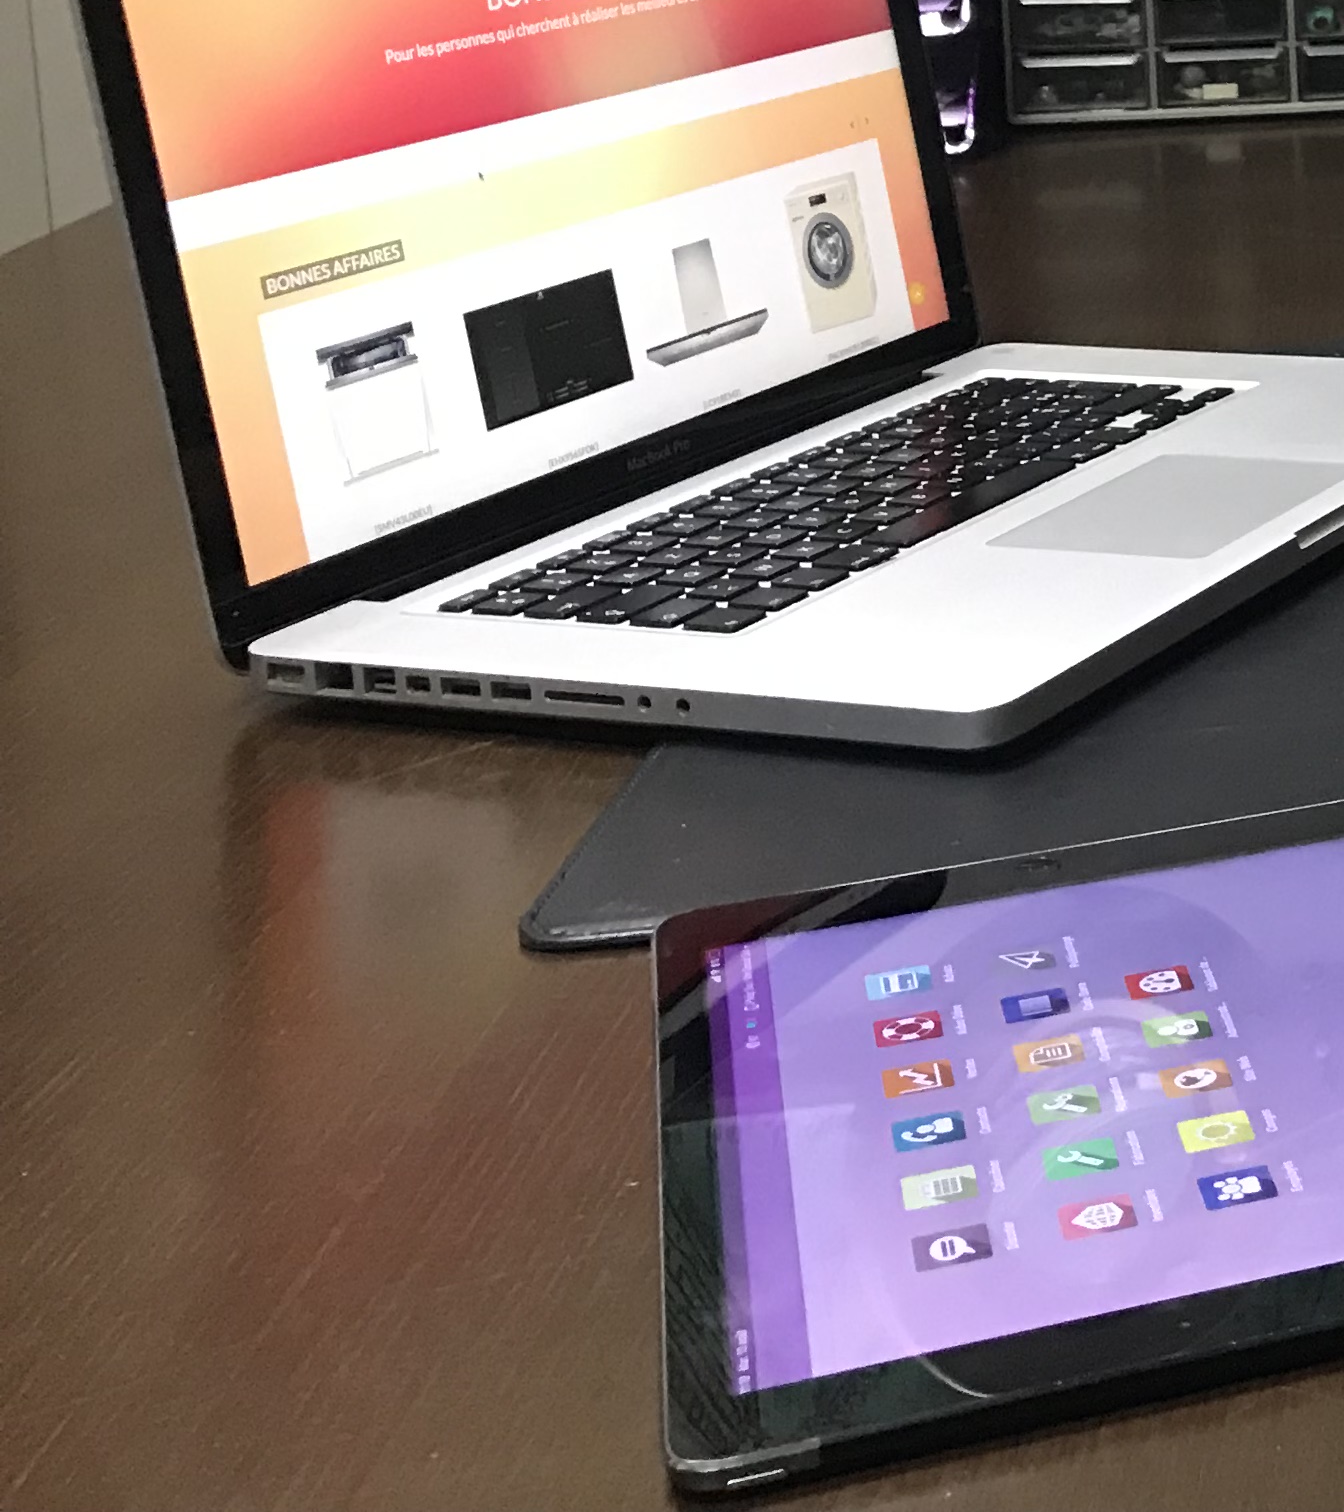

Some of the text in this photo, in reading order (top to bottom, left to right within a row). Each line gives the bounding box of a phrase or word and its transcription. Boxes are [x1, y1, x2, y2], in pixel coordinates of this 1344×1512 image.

[385, 46, 415, 65] Pour
[416, 43, 435, 58] les
[436, 32, 496, 57] personnes
[497, 25, 515, 44] qui
[516, 16, 571, 38] cherchent
[580, 5, 619, 25] réaliser
[620, 2, 636, 16] les
[265, 244, 401, 295] BONNES AFFAIRES
